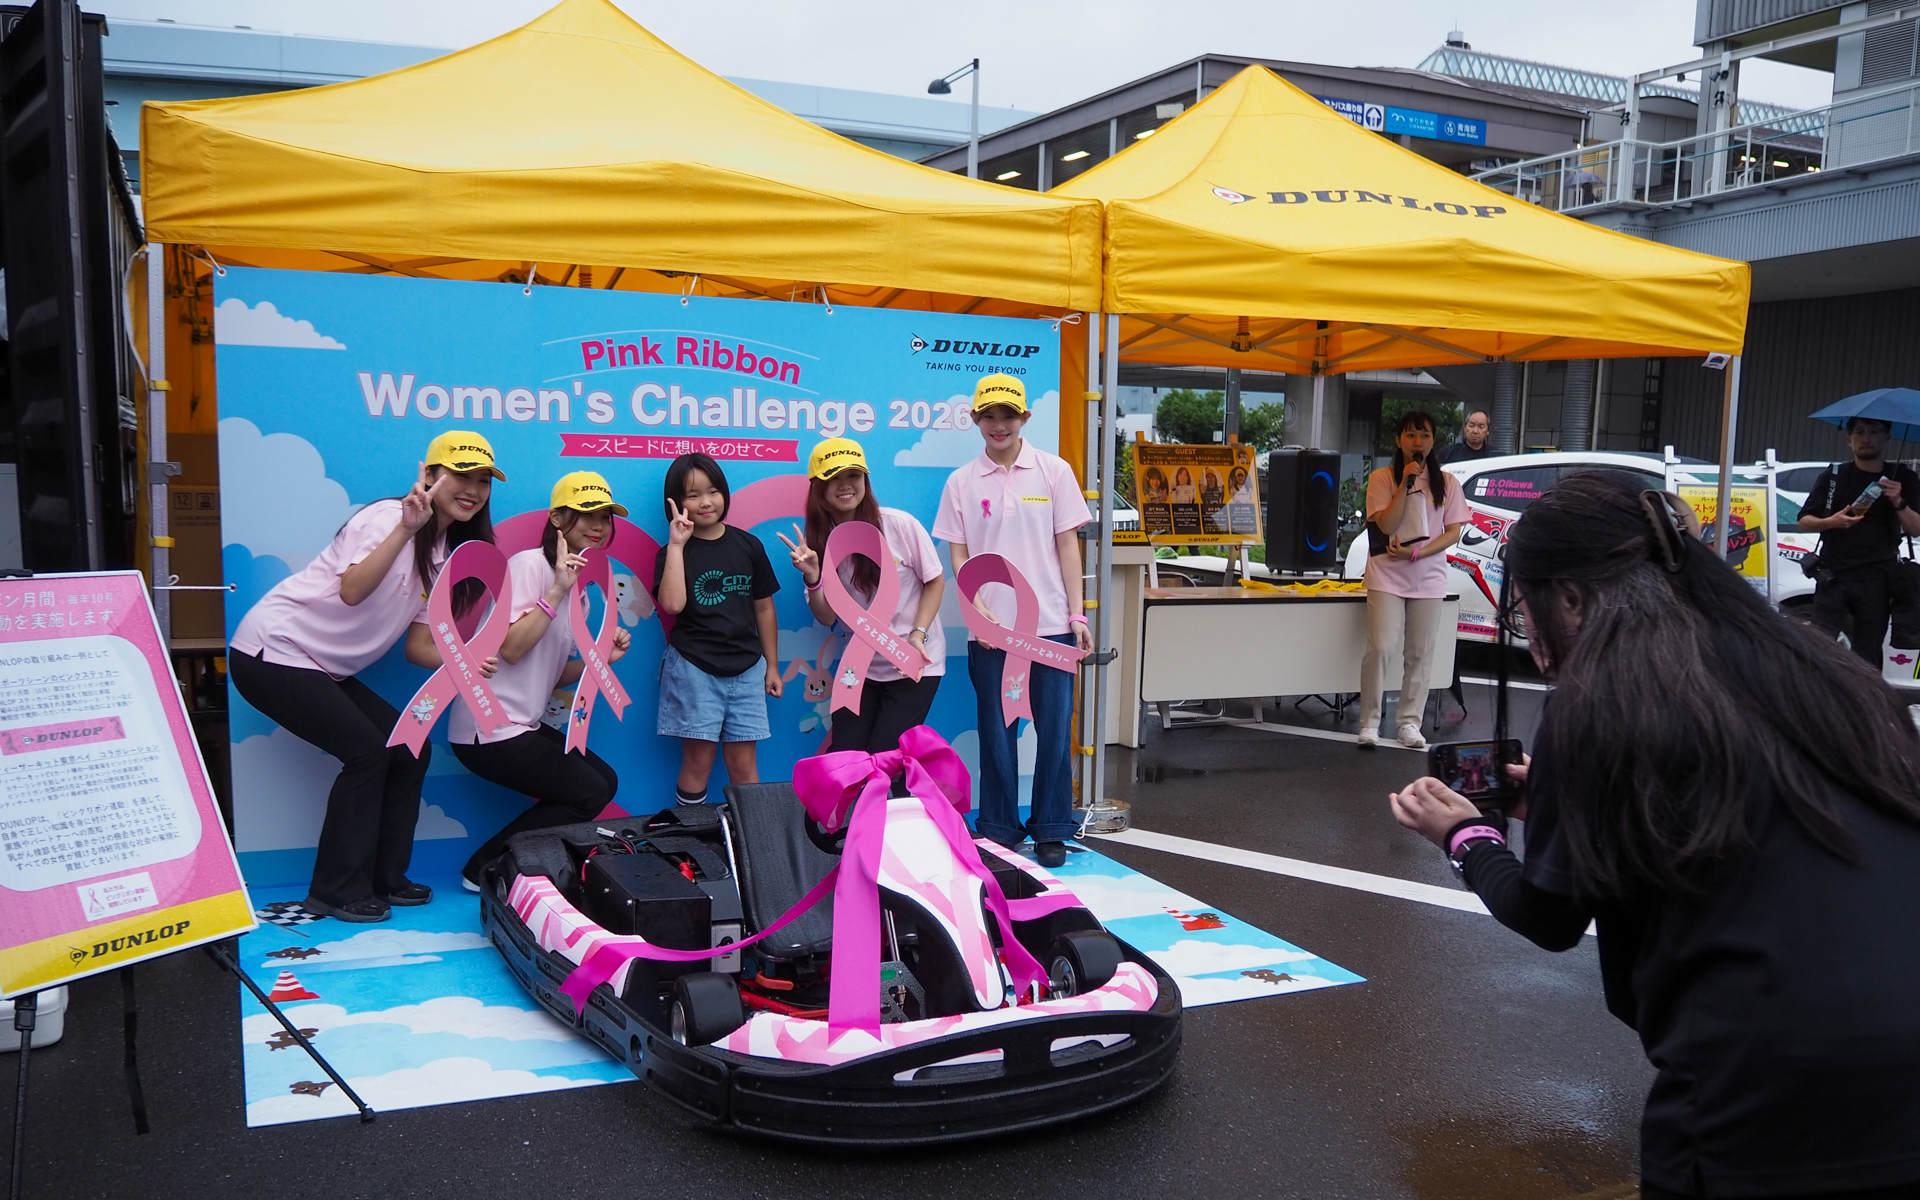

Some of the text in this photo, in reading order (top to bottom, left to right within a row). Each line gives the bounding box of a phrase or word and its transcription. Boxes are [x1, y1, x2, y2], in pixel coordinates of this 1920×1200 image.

[1266, 190, 1507, 218] DUNLOP
[931, 339, 1040, 358] DUNLOP
[581, 336, 801, 385] Pink Ribbon
[926, 362, 1027, 375] TAKING YOU BEYOND
[984, 386, 1022, 397] DUNLOP
[358, 371, 974, 438] Women's Challenge 2026
[824, 449, 862, 460] DUNLOP
[1489, 479, 1533, 489] S.Oikawa
[1486, 488, 1543, 498] M.Yamamot
[1694, 503, 1717, 513] ストッ
[722, 574, 752, 586] CITY
[0, 590, 55, 608] ン月間
[37, 726, 103, 743] DUNLOP
[91, 920, 190, 958] DUNLOP
